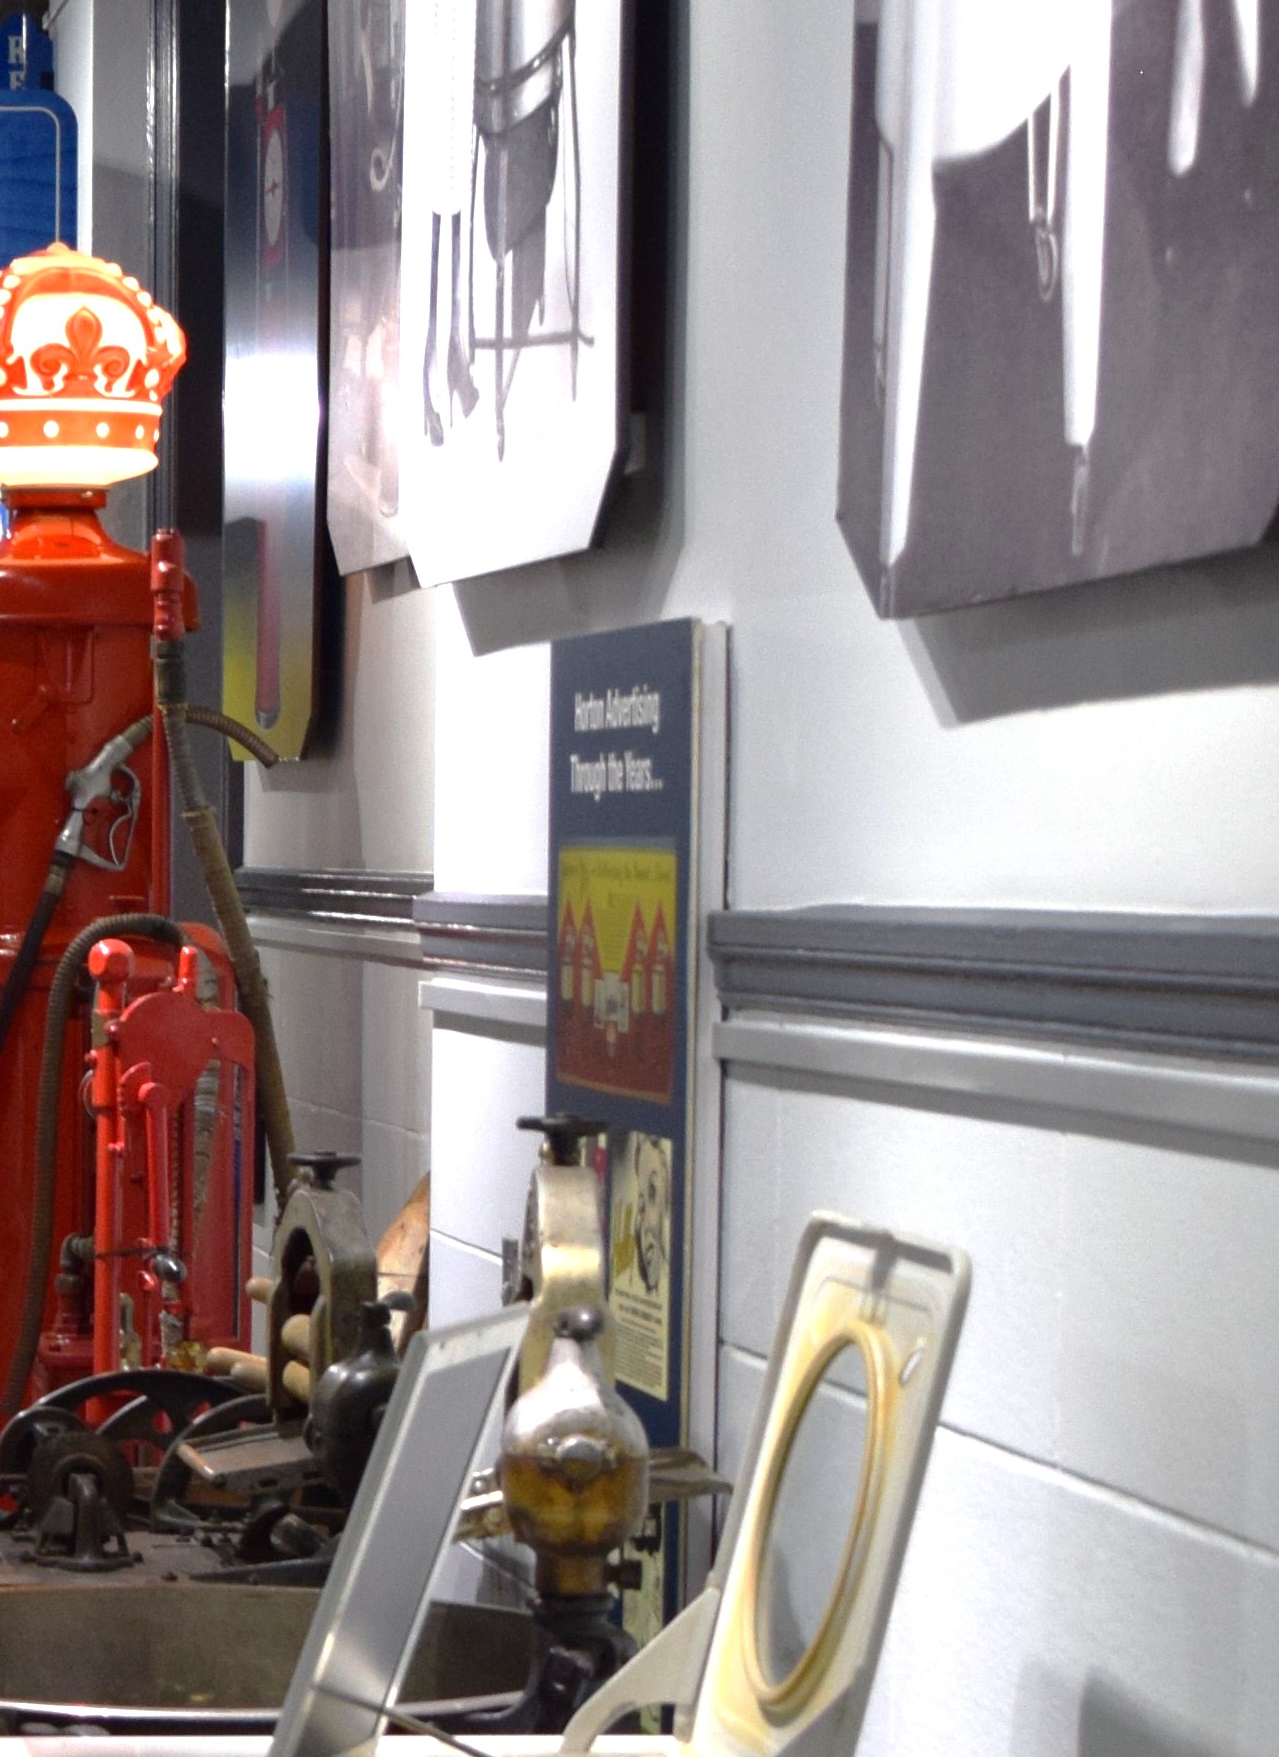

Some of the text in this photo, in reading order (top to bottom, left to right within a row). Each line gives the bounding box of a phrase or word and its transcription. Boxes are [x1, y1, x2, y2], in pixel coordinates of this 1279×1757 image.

[574, 684, 659, 734] Horton Advertising
[570, 752, 605, 801] Through
[607, 751, 623, 792] the
